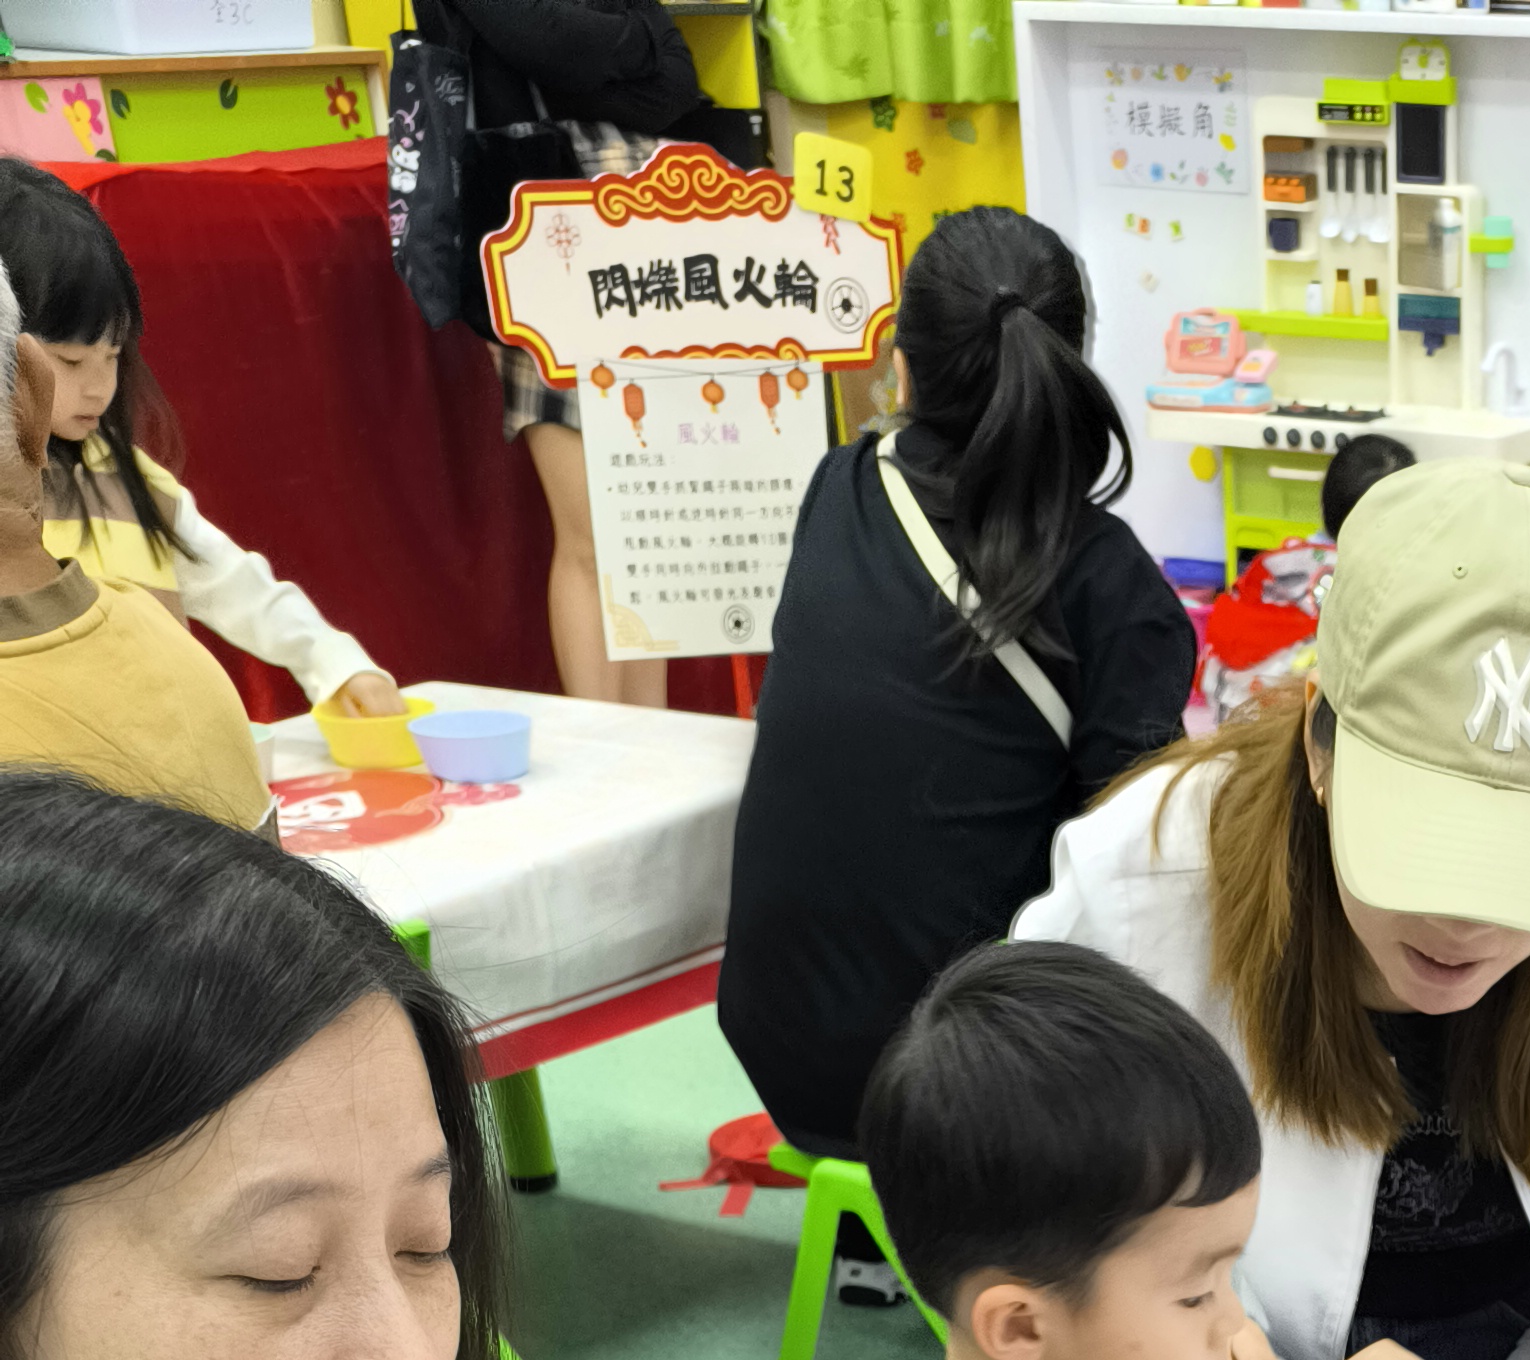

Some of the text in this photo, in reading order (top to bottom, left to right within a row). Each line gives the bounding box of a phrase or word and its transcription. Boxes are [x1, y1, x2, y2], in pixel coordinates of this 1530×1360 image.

[1126, 101, 1214, 139] 模擬角
[814, 159, 856, 202] 13
[587, 252, 820, 320] 閃爍風火輪
[677, 422, 742, 446] 風火輪
